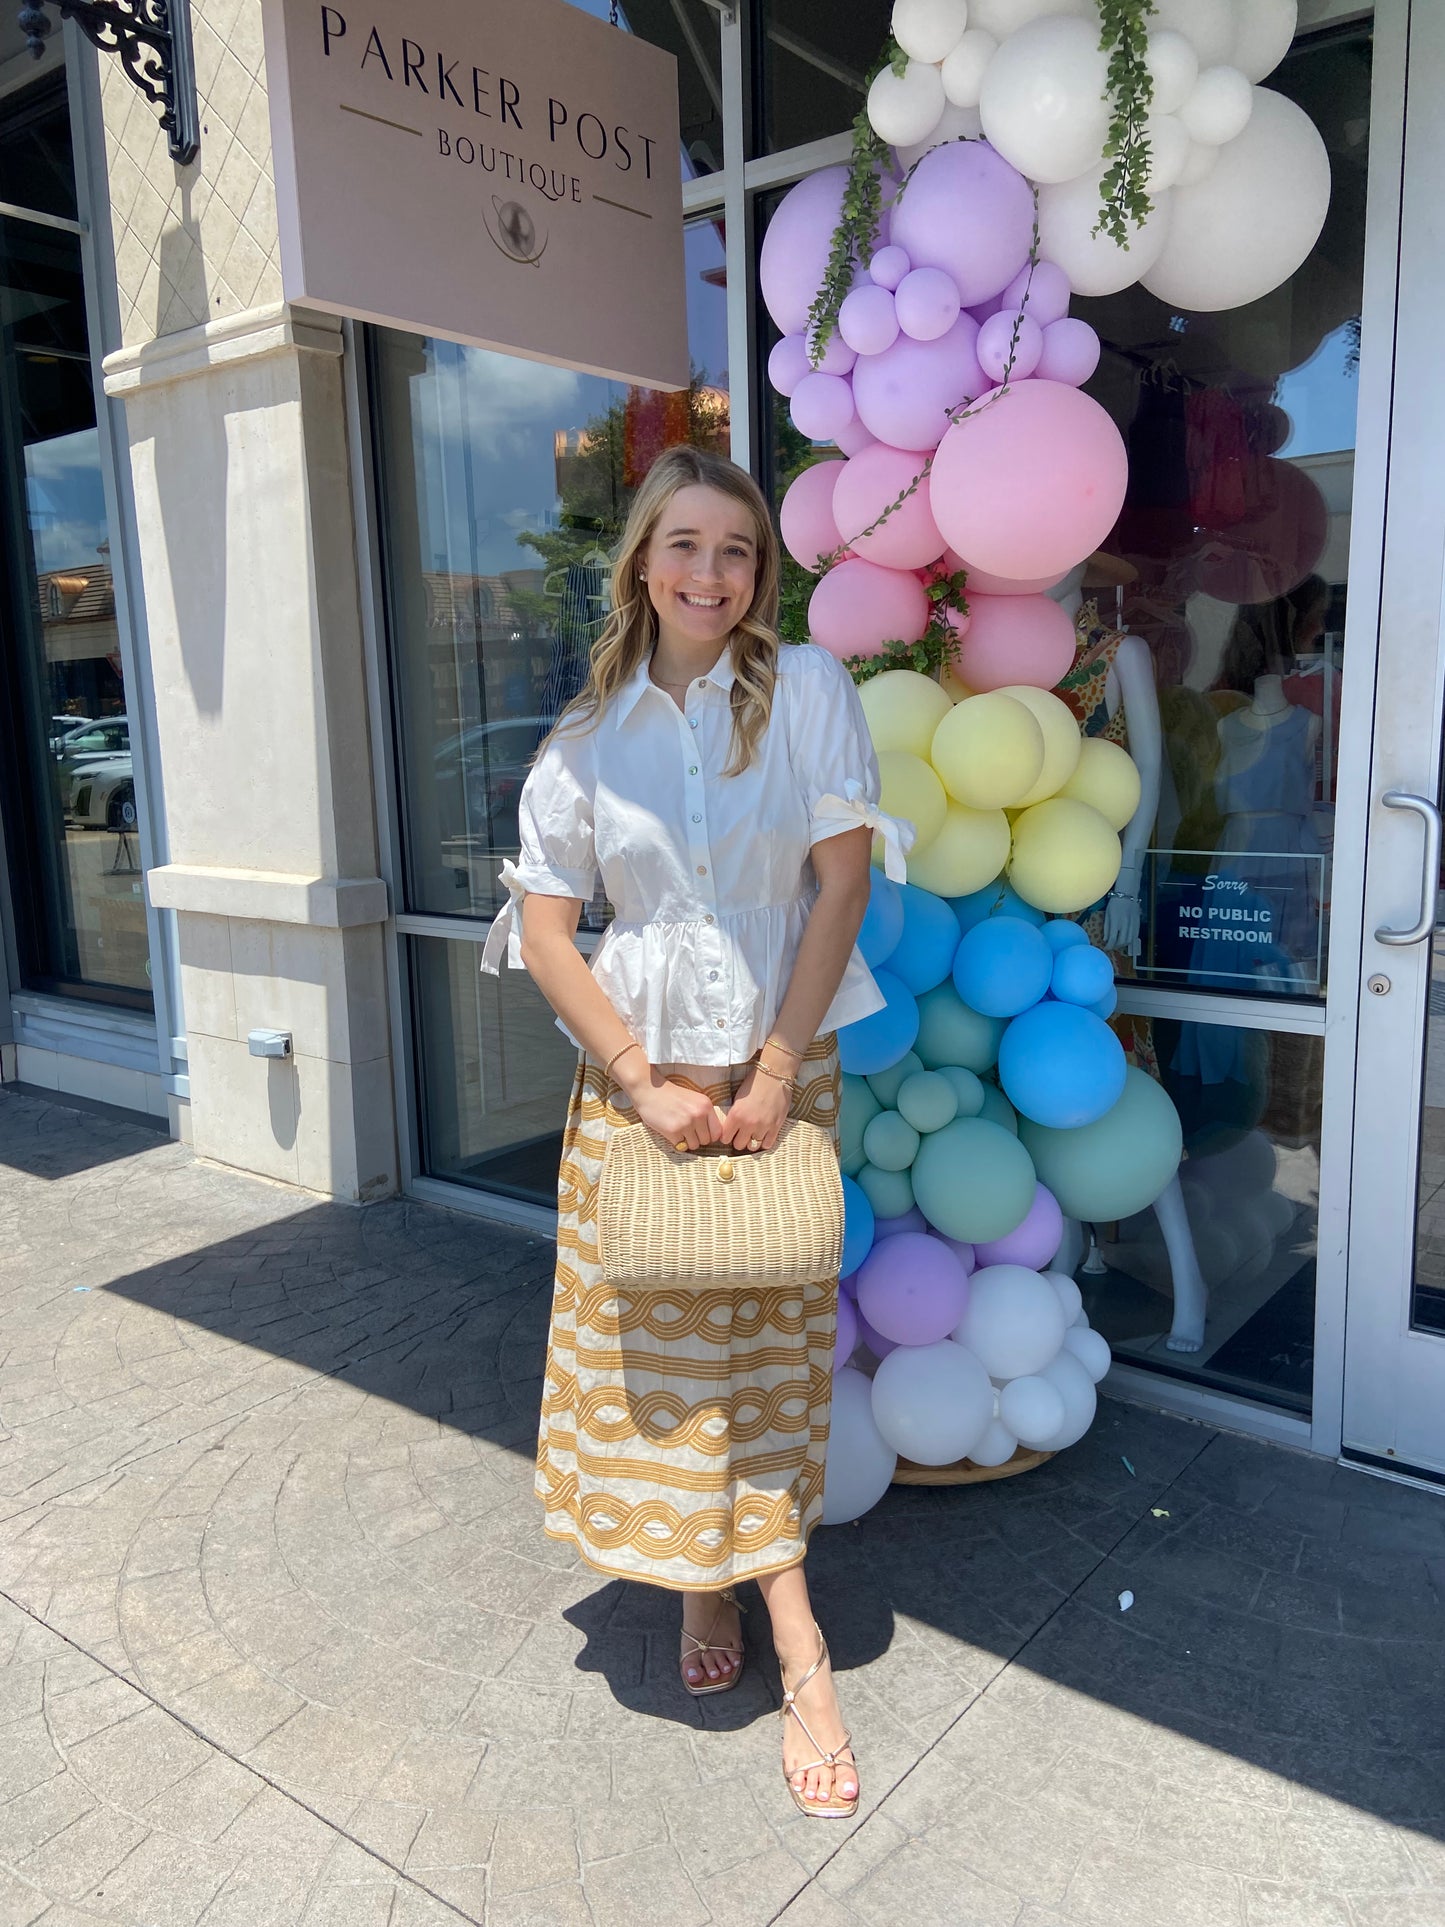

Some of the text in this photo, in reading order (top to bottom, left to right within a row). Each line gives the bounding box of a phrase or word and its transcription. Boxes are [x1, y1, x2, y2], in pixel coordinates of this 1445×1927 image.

[321, 6, 656, 179] PARKER POST
[438, 129, 582, 203] BOUTIQUE
[1202, 875, 1248, 895] Sorry
[1179, 906, 1271, 922] NO PUBLIC
[1179, 926, 1272, 943] RESTROOM
